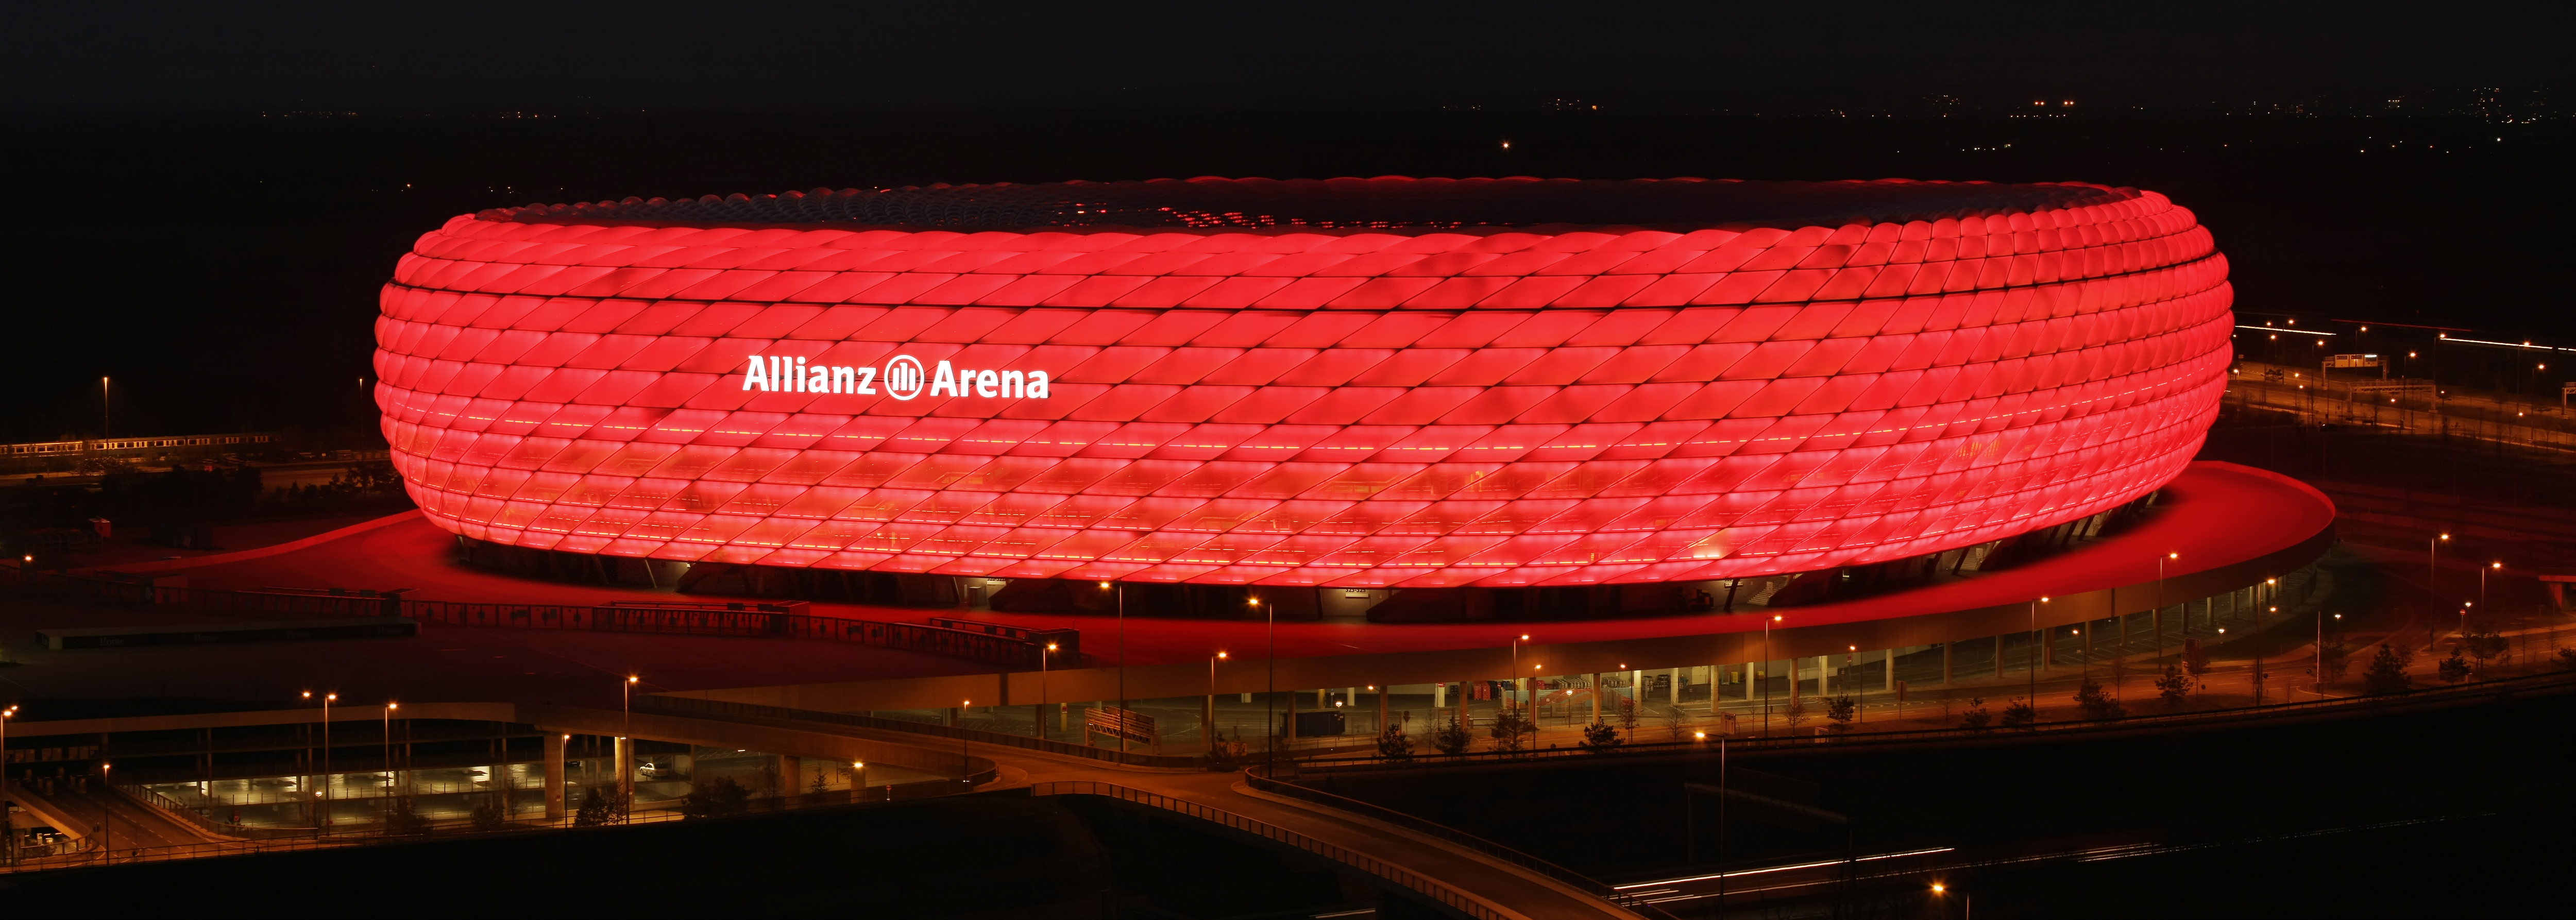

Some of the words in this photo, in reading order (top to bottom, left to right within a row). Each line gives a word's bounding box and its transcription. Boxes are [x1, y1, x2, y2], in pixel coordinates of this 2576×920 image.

[742, 354, 877, 395] Allianz
[930, 360, 1049, 399] Arena
[99, 637, 125, 646] Home
[194, 634, 218, 642] Home
